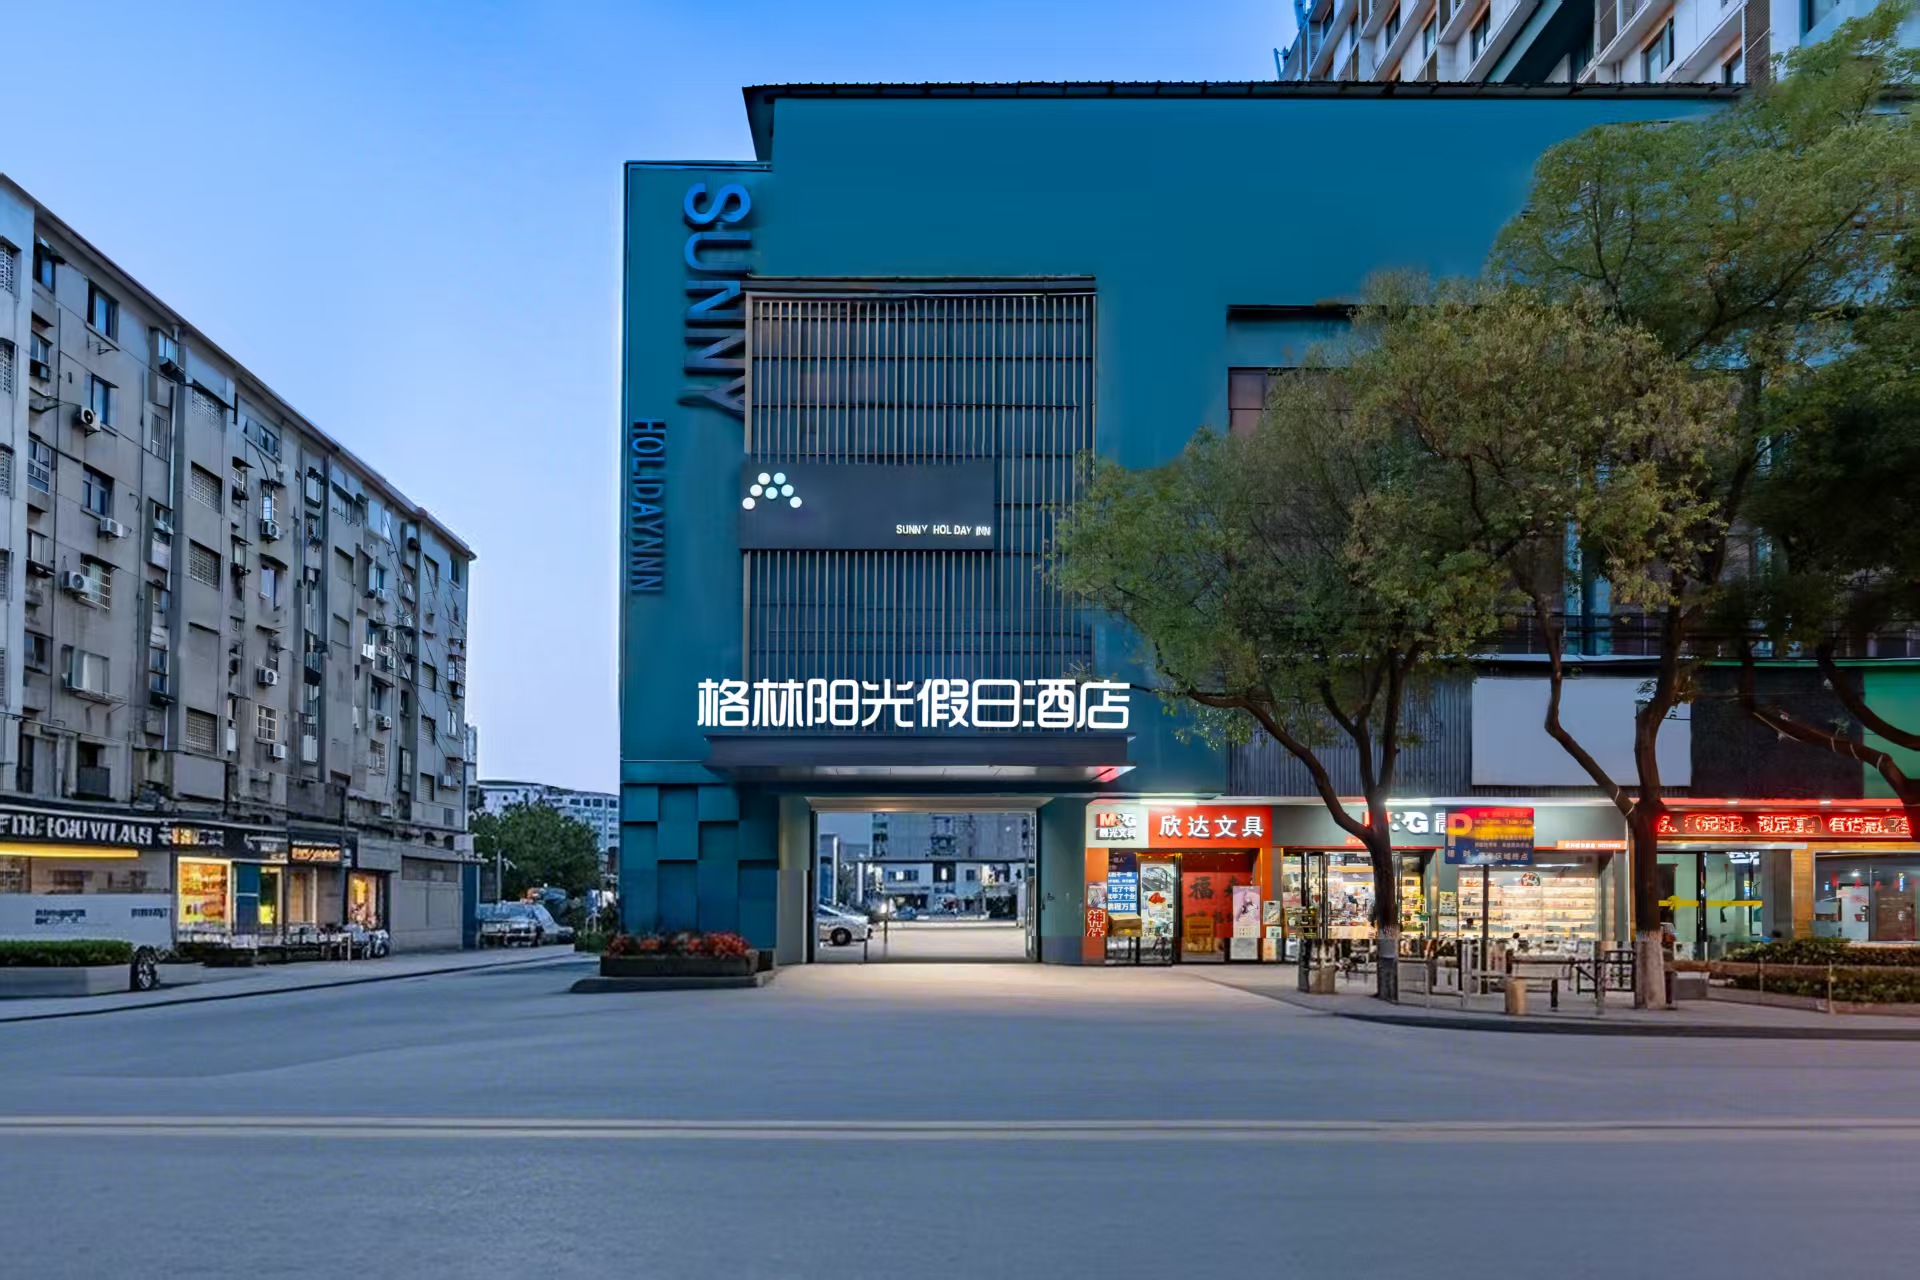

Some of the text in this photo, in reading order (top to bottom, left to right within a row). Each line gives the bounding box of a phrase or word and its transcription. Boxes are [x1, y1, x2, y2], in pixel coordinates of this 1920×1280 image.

[684, 183, 750, 412] SUNNY
[896, 524, 928, 535] SUNNY
[975, 526, 991, 536] INN
[697, 677, 1131, 729] 格林阳光假日酒店
[1098, 812, 1137, 828] M&G
[1159, 815, 1264, 838] 欣达文具
[1448, 813, 1473, 846] P
[1188, 876, 1214, 900] 福
